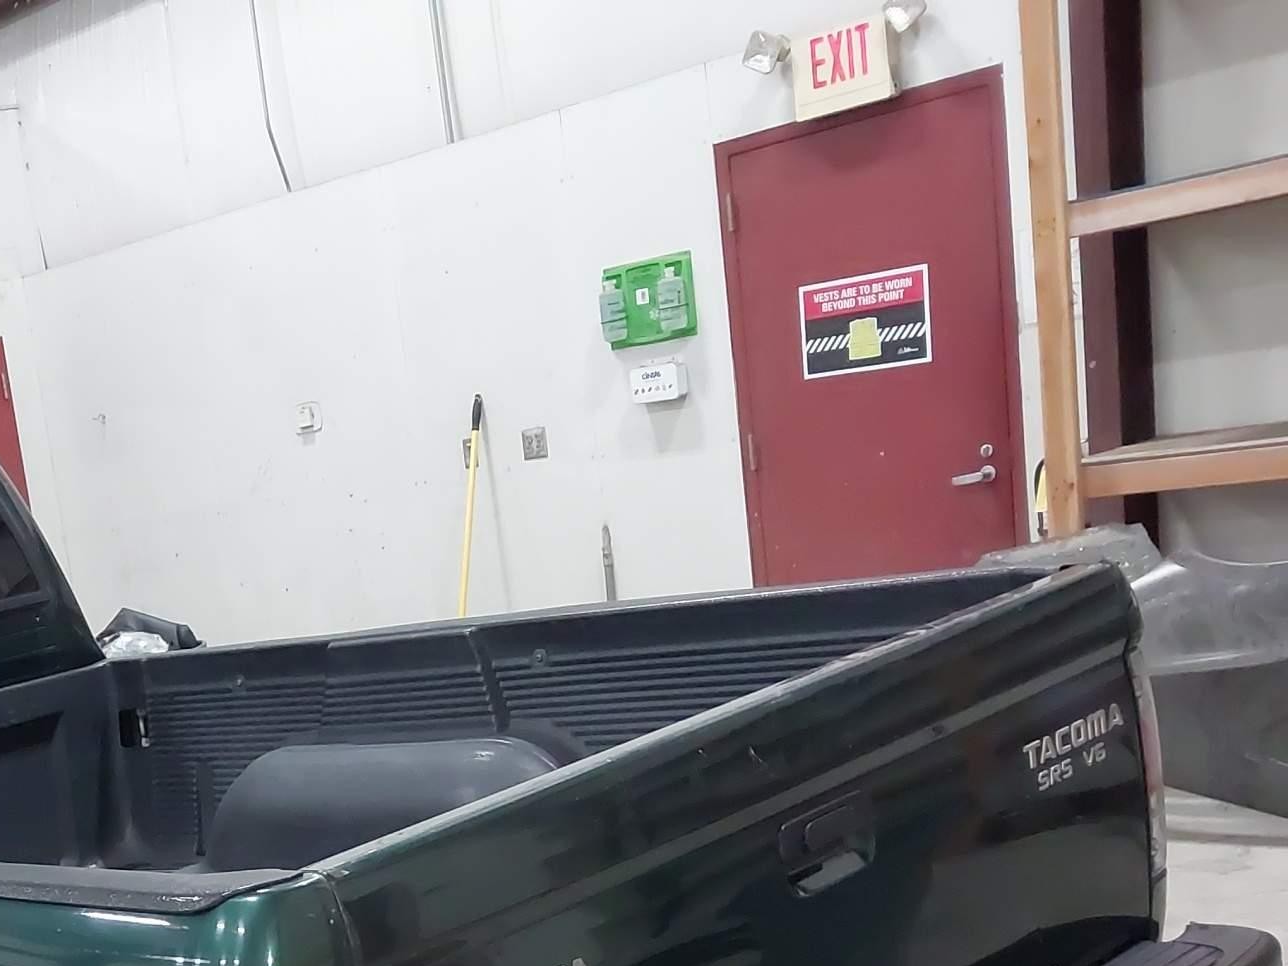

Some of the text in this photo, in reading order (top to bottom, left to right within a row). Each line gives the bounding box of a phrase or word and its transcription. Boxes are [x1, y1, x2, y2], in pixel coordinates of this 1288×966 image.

[810, 22, 869, 89] EXIT
[813, 277, 912, 303] VESTS ARE TO BE WORN
[822, 289, 905, 313] BEYOND THIS POINT
[1023, 703, 1124, 769] TACOMA
[1038, 742, 1106, 791] SR5 V6
